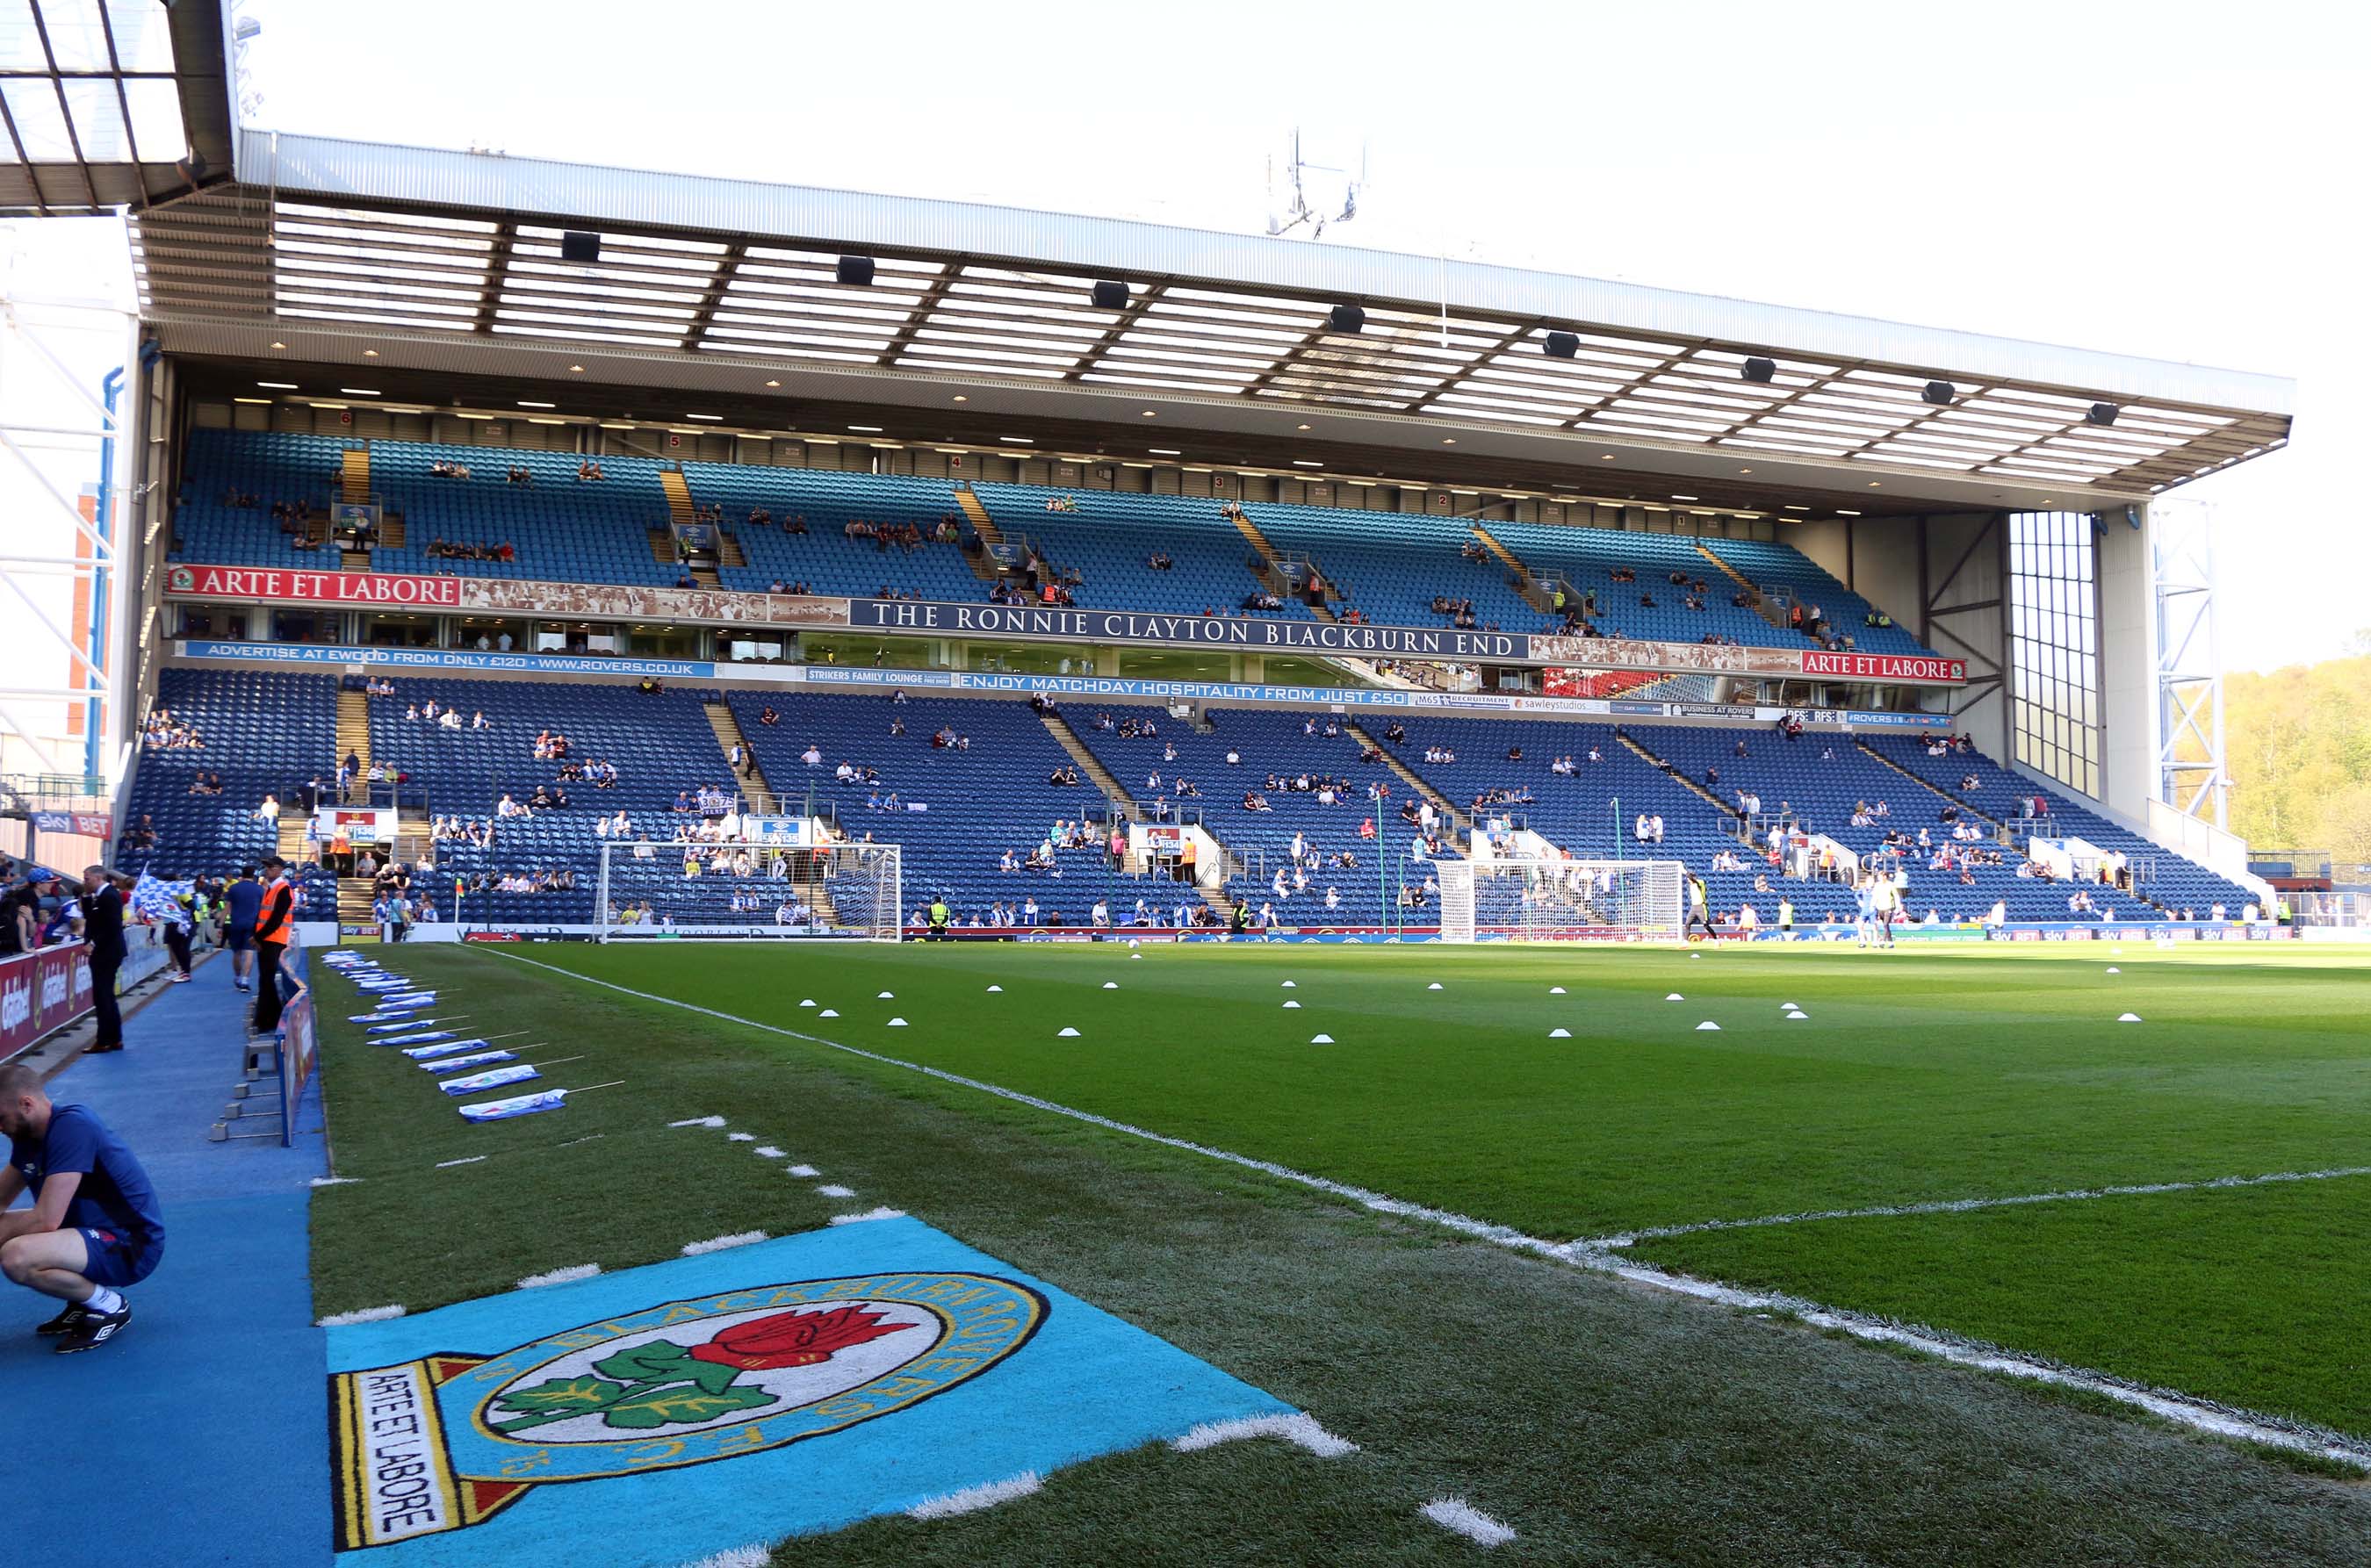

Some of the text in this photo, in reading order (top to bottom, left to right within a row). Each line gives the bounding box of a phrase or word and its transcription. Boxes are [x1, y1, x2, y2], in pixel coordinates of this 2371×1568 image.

[671, 437, 679, 446] 5
[952, 457, 960, 466] 4
[202, 570, 455, 603] ARTE ET LABORE
[873, 604, 1512, 656] THE RONNIE CLAYTON BLACKBURN END
[208, 644, 694, 674] ADVERTISE AT EWOOD FROM ONLY £120 WWW.ROVERS.CO.UK
[1805, 654, 1948, 679] ARTE ET LABORE
[809, 670, 849, 680] STRIKERS
[852, 672, 884, 681] FAMILY
[885, 673, 923, 683] LOUNGE
[961, 674, 1405, 703] ENJOY MATCHDAY HOSPITALITY FROM JUST £50
[1524, 700, 1587, 710] sawleystudios
[1682, 705, 1715, 714] BUSINESS
[1849, 714, 1892, 723] #ROVERS
[37, 814, 108, 835] sky BET
[551, 1279, 1000, 1349] BLACKBURN
[814, 1298, 1019, 1420] ROVERS
[368, 1373, 436, 1533] ARTE ET LABORE
